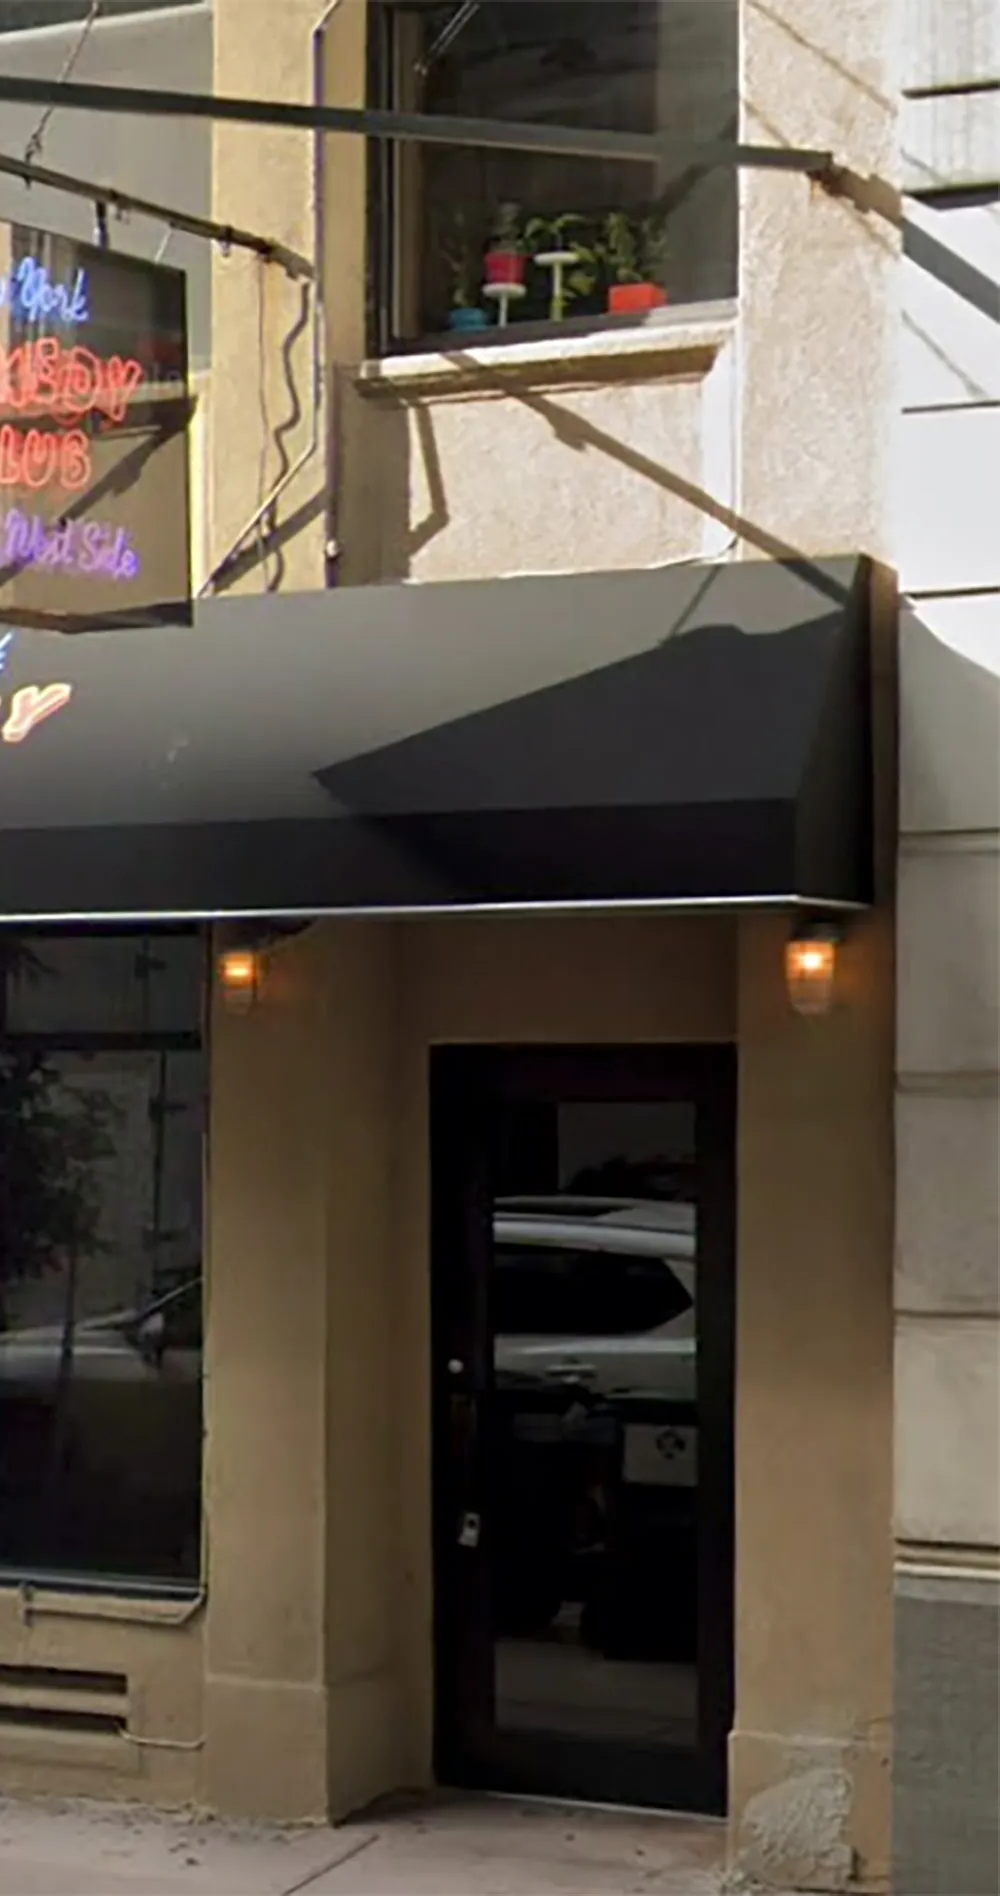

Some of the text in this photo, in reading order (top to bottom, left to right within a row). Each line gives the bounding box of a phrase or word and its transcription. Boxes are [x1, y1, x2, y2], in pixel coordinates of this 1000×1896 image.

[16, 256, 88, 322] York
[4, 508, 73, 567] West
[80, 521, 138, 577] Side
